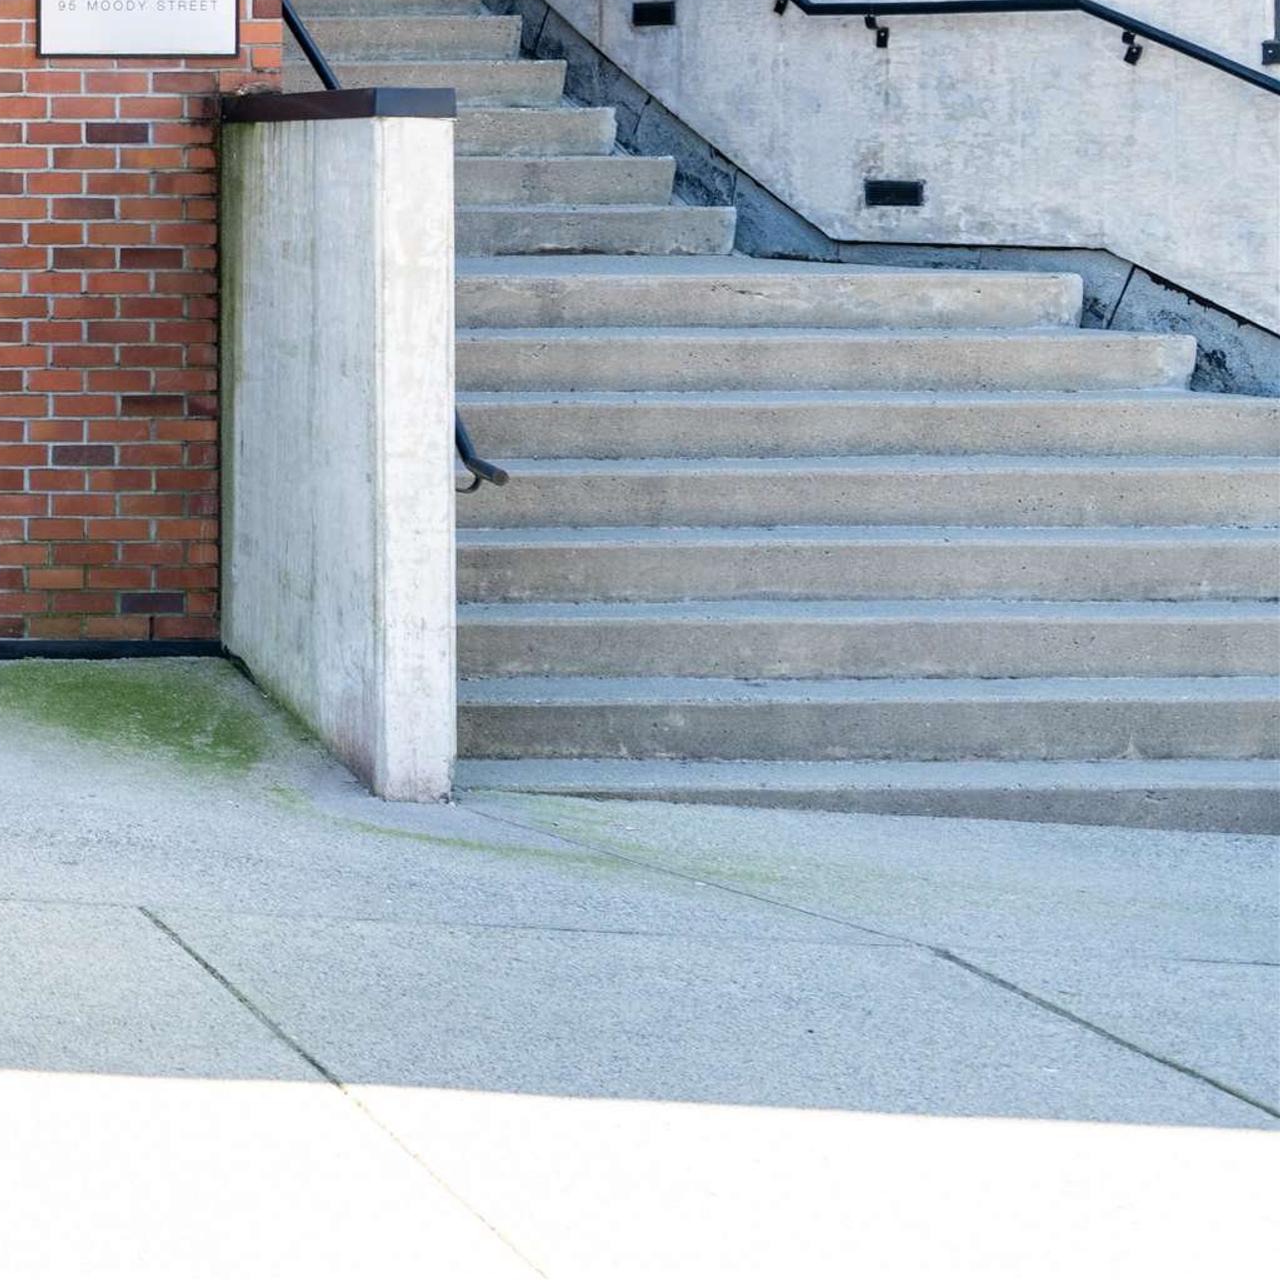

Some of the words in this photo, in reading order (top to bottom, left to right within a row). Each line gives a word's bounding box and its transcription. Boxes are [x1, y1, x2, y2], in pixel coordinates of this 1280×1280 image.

[57, 0, 77, 12] 95
[86, 0, 146, 12] MOODY
[156, 0, 218, 12] STREET
